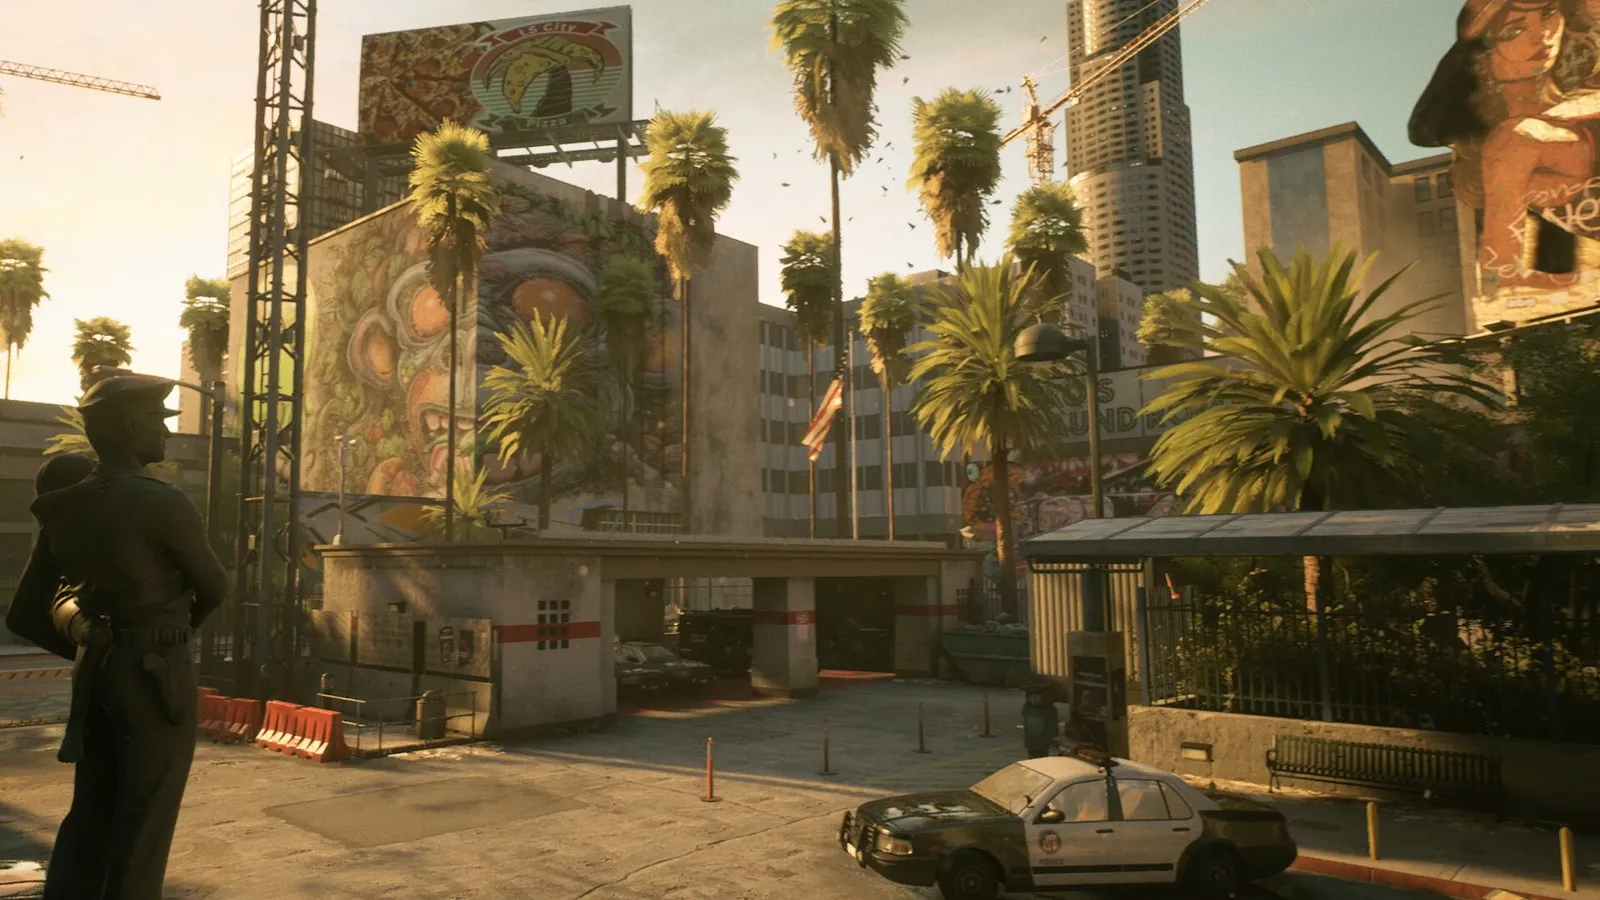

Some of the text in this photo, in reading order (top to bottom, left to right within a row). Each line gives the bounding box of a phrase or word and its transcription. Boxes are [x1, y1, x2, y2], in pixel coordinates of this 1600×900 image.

[543, 21, 577, 33] City
[526, 117, 567, 128] Pizza
[1039, 858, 1065, 866] POLICE
